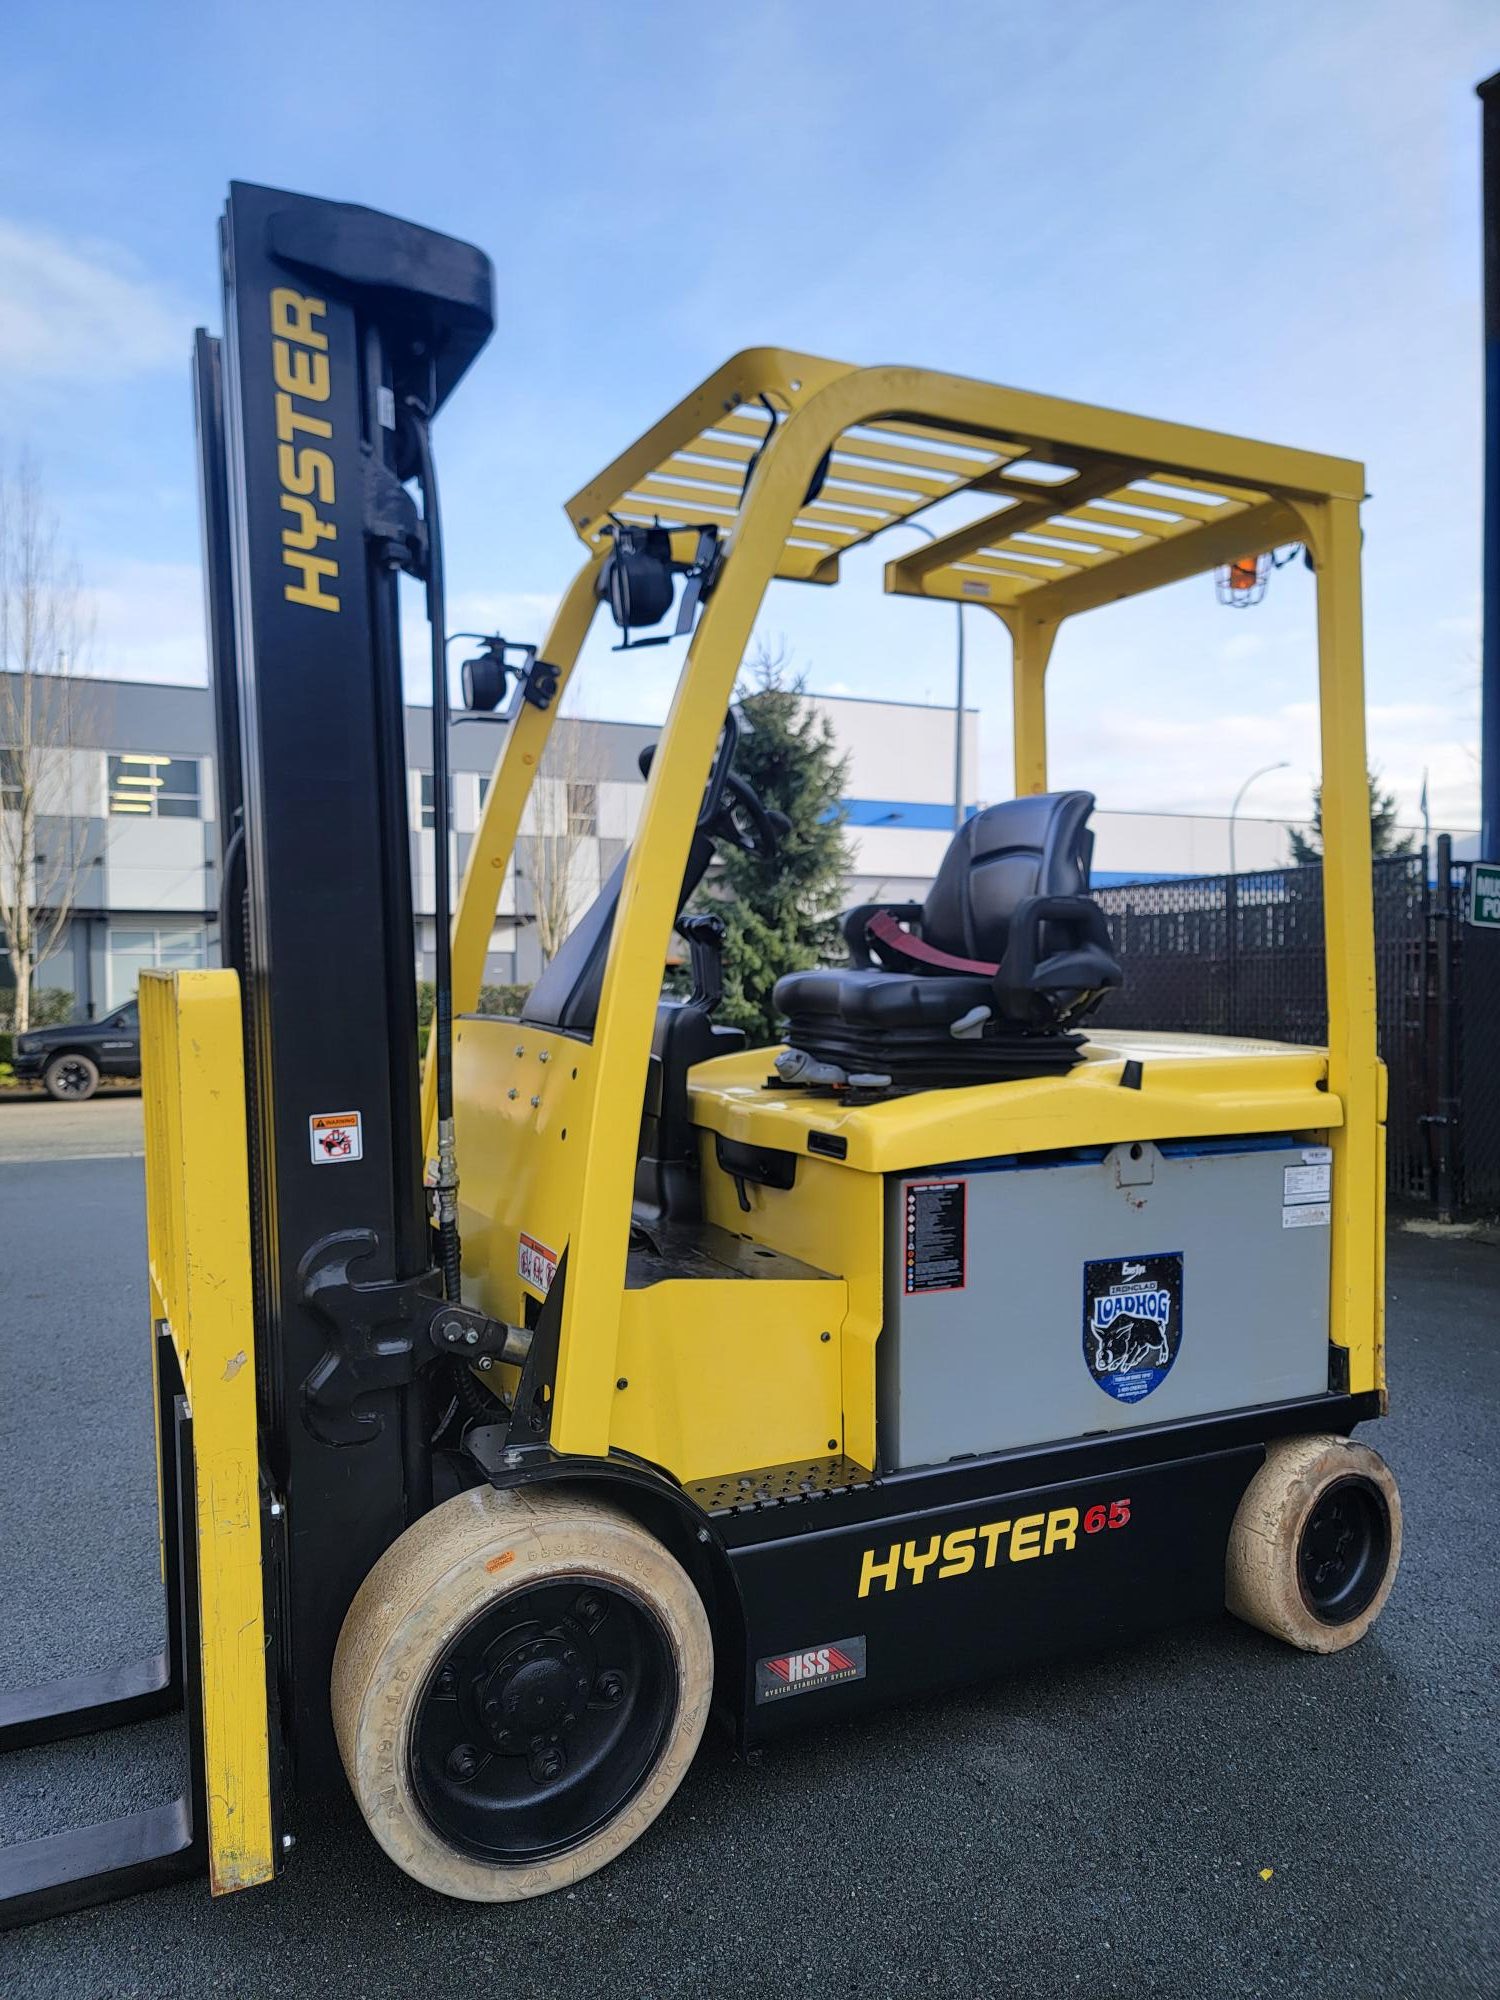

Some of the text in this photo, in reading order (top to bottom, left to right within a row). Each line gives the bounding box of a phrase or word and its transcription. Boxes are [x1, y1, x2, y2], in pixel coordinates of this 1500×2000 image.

[270, 287, 341, 613] HYSTER
[1111, 1282, 1156, 1294] IRONCLAD
[1096, 1291, 1169, 1325] LOADHOG
[857, 1498, 1132, 1598] HYSTER 65
[788, 1649, 829, 1682] HSS
[793, 1676, 828, 1690] STABILITY
[830, 1669, 857, 1681] SYSTEM
